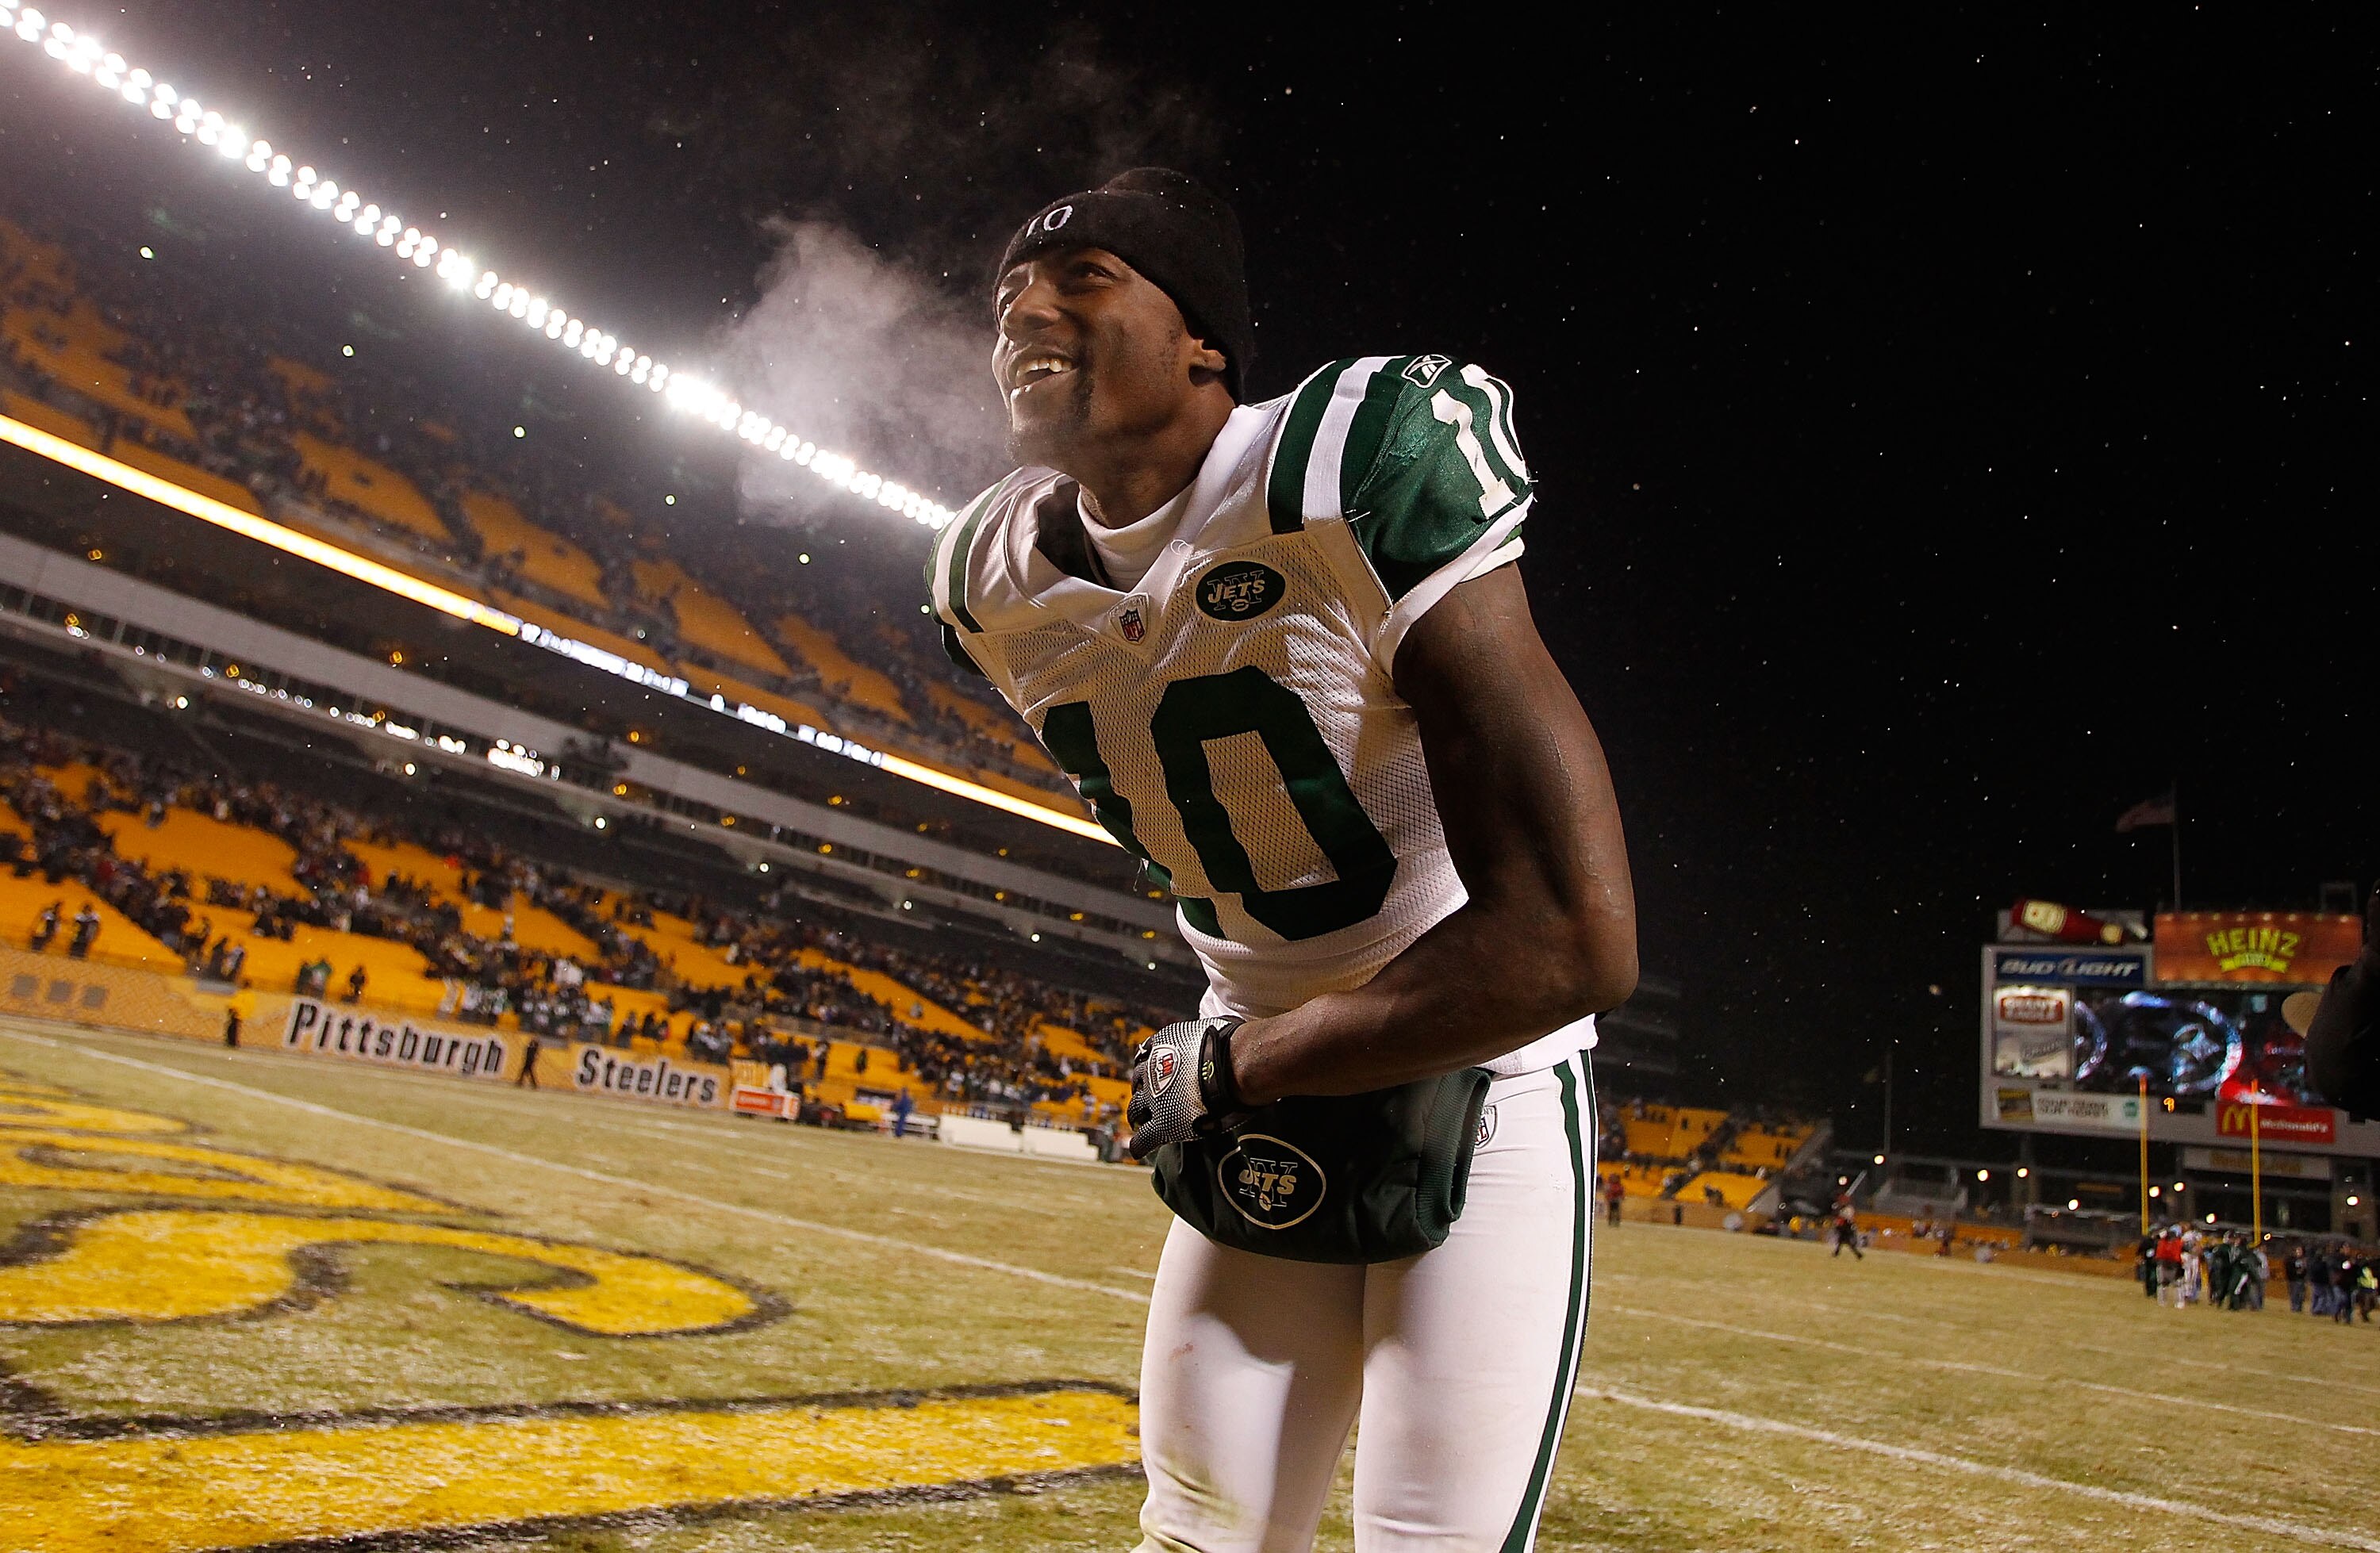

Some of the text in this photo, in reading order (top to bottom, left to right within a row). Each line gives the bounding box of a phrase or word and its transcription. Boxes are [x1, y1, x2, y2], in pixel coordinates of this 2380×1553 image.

[1207, 579, 1266, 604] JETS
[1124, 620, 1144, 639] NFL
[1042, 665, 1398, 942] 10
[2206, 927, 2299, 957] HEINZ
[2001, 957, 2140, 977] BUD LIGHT
[289, 1002, 716, 1102] Pittsburgh Steelers
[2259, 1118, 2328, 1133] McDonald's
